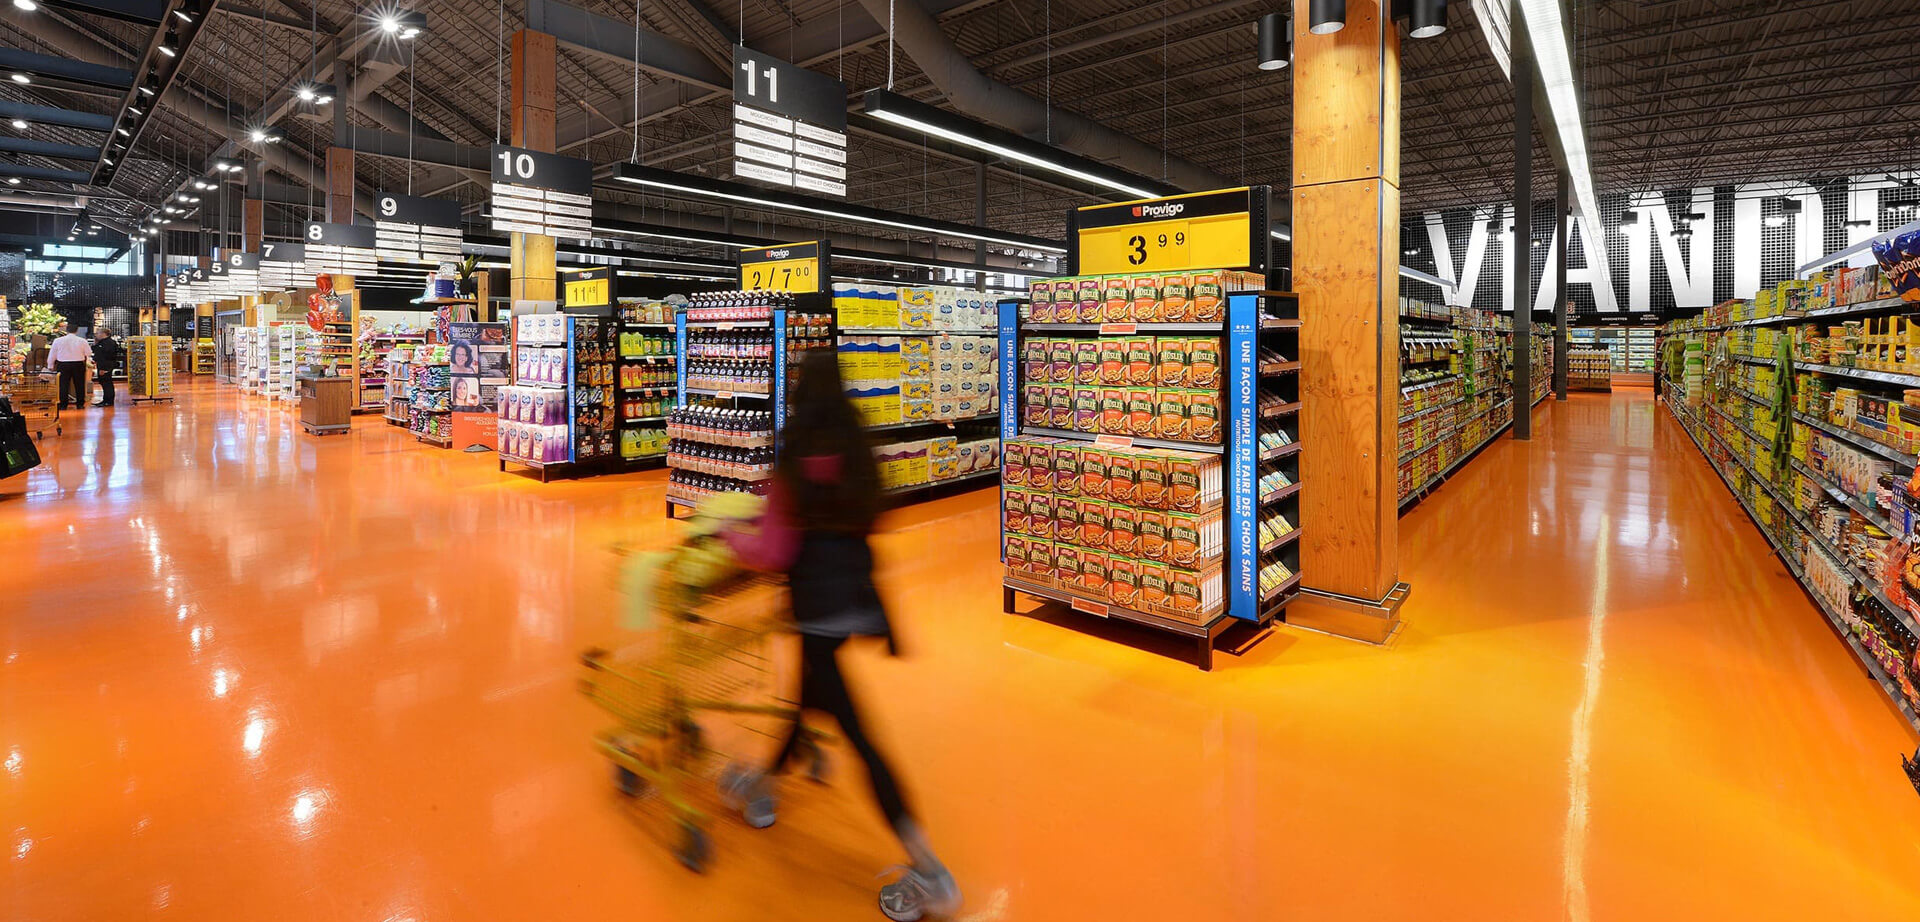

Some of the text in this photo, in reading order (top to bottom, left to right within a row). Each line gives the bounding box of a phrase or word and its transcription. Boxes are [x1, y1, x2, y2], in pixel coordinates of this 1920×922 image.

[742, 60, 777, 102] 11
[498, 151, 534, 178] 10
[381, 197, 397, 216] 9
[1143, 202, 1184, 217] Provigo
[308, 224, 322, 240] 8
[263, 244, 274, 257] 7
[770, 249, 790, 258] Provigo
[1128, 235, 1147, 265] 3
[211, 262, 222, 273] 5
[231, 254, 242, 266] 6
[167, 278, 175, 287] 2
[178, 274, 188, 283] 3
[192, 270, 202, 279] 4
[1241, 341, 1250, 363] UNE
[1240, 368, 1250, 404] FAÇON
[1242, 408, 1250, 445] SIMPLE
[1242, 451, 1250, 462] DE
[1242, 465, 1250, 495] FAIRE
[1242, 497, 1250, 517] DES
[1242, 520, 1251, 556] CHOIX
